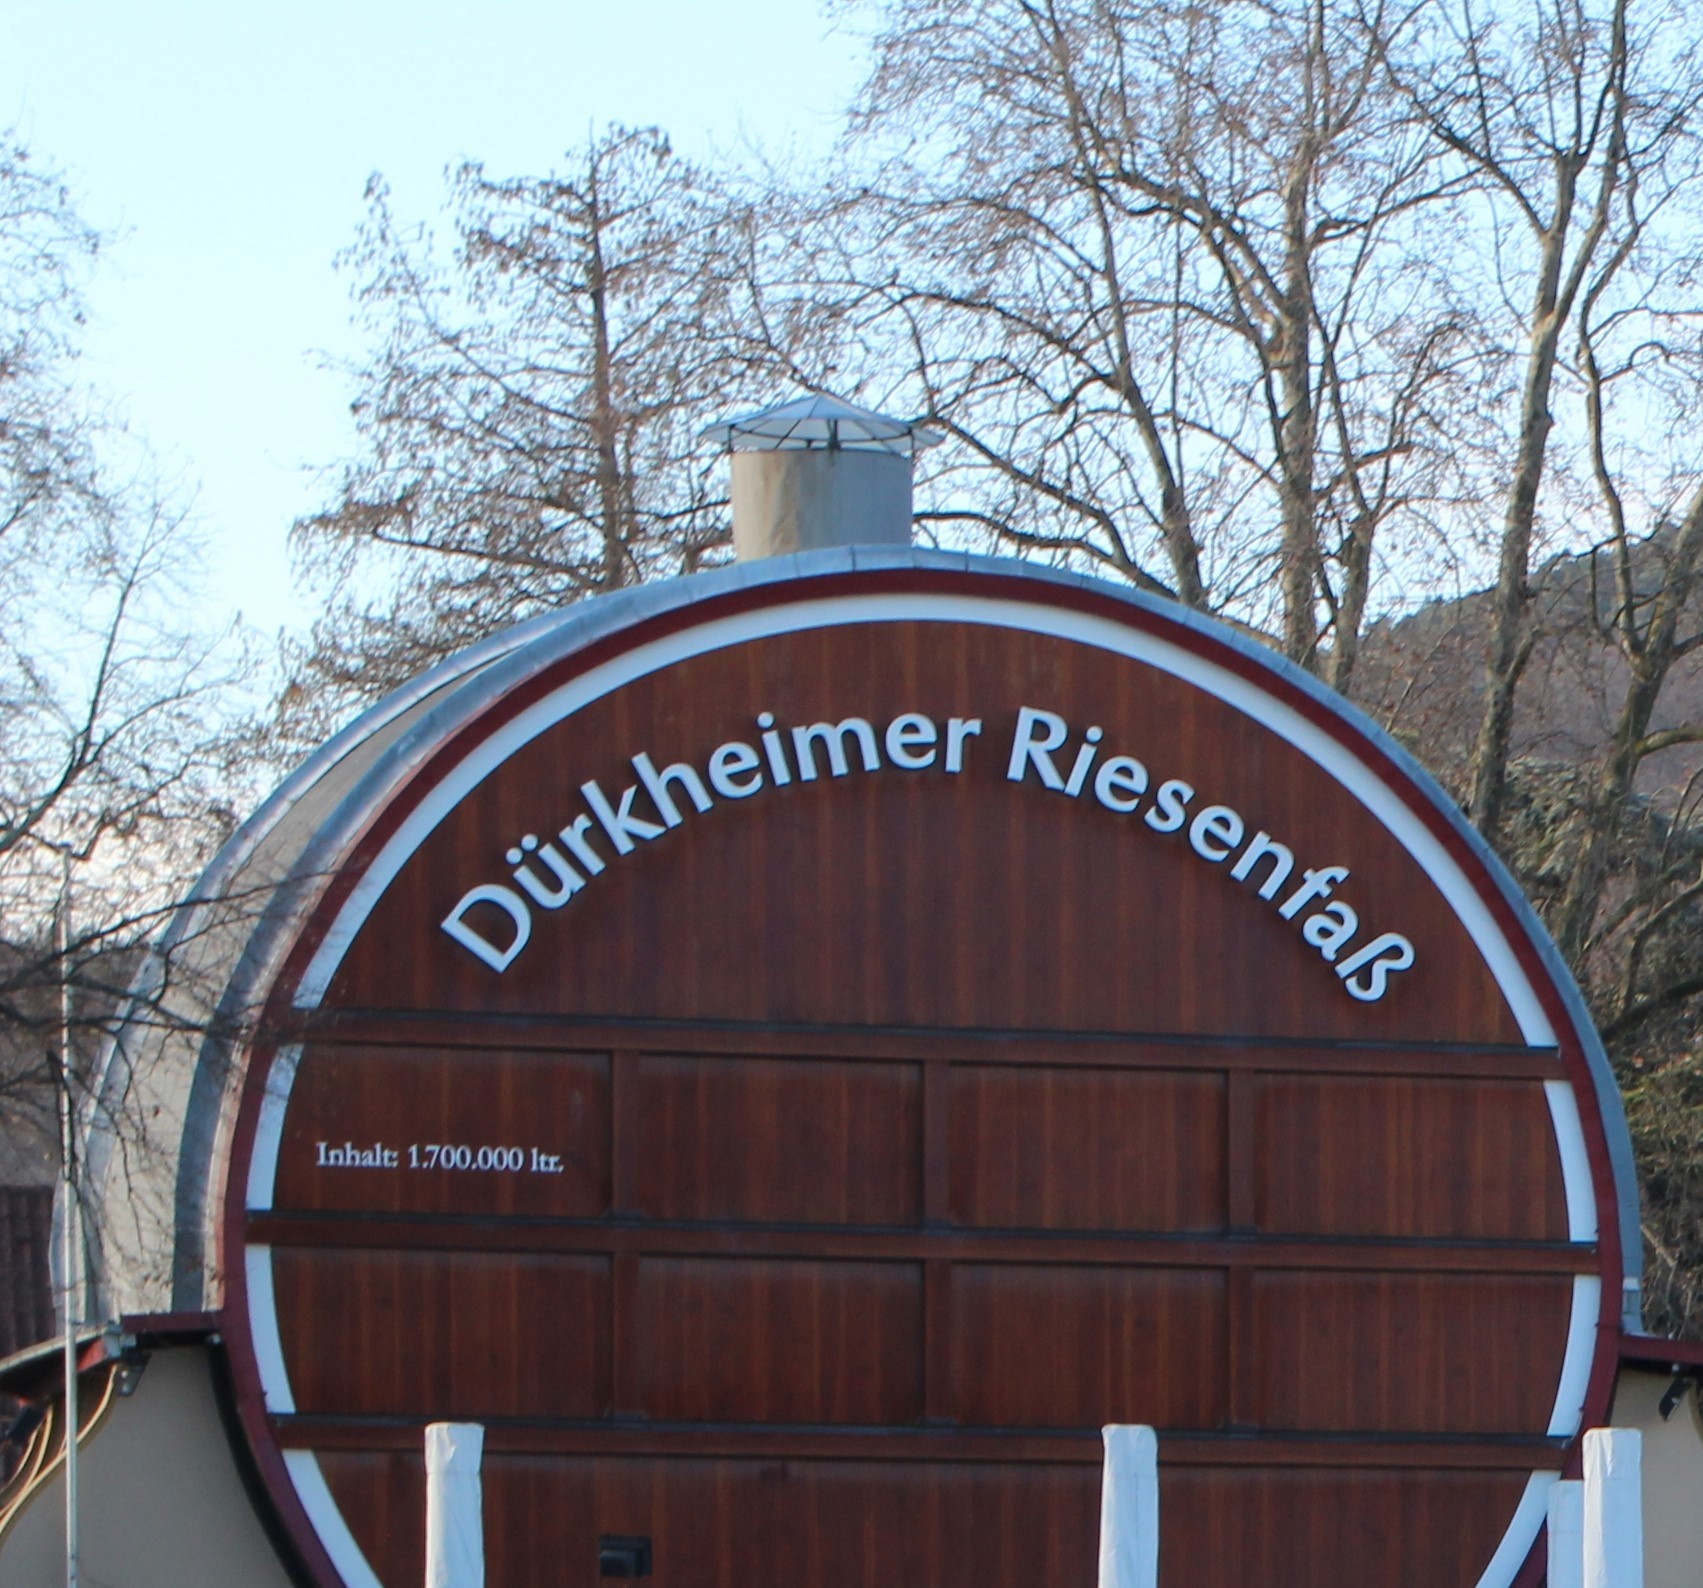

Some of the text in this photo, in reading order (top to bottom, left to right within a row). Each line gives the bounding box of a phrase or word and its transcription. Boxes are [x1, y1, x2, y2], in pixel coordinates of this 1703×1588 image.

[441, 706, 1416, 1002] Dürkheimer Riesenfaß
[316, 1141, 565, 1173] Inhalt: 1.700.000 ltr.
